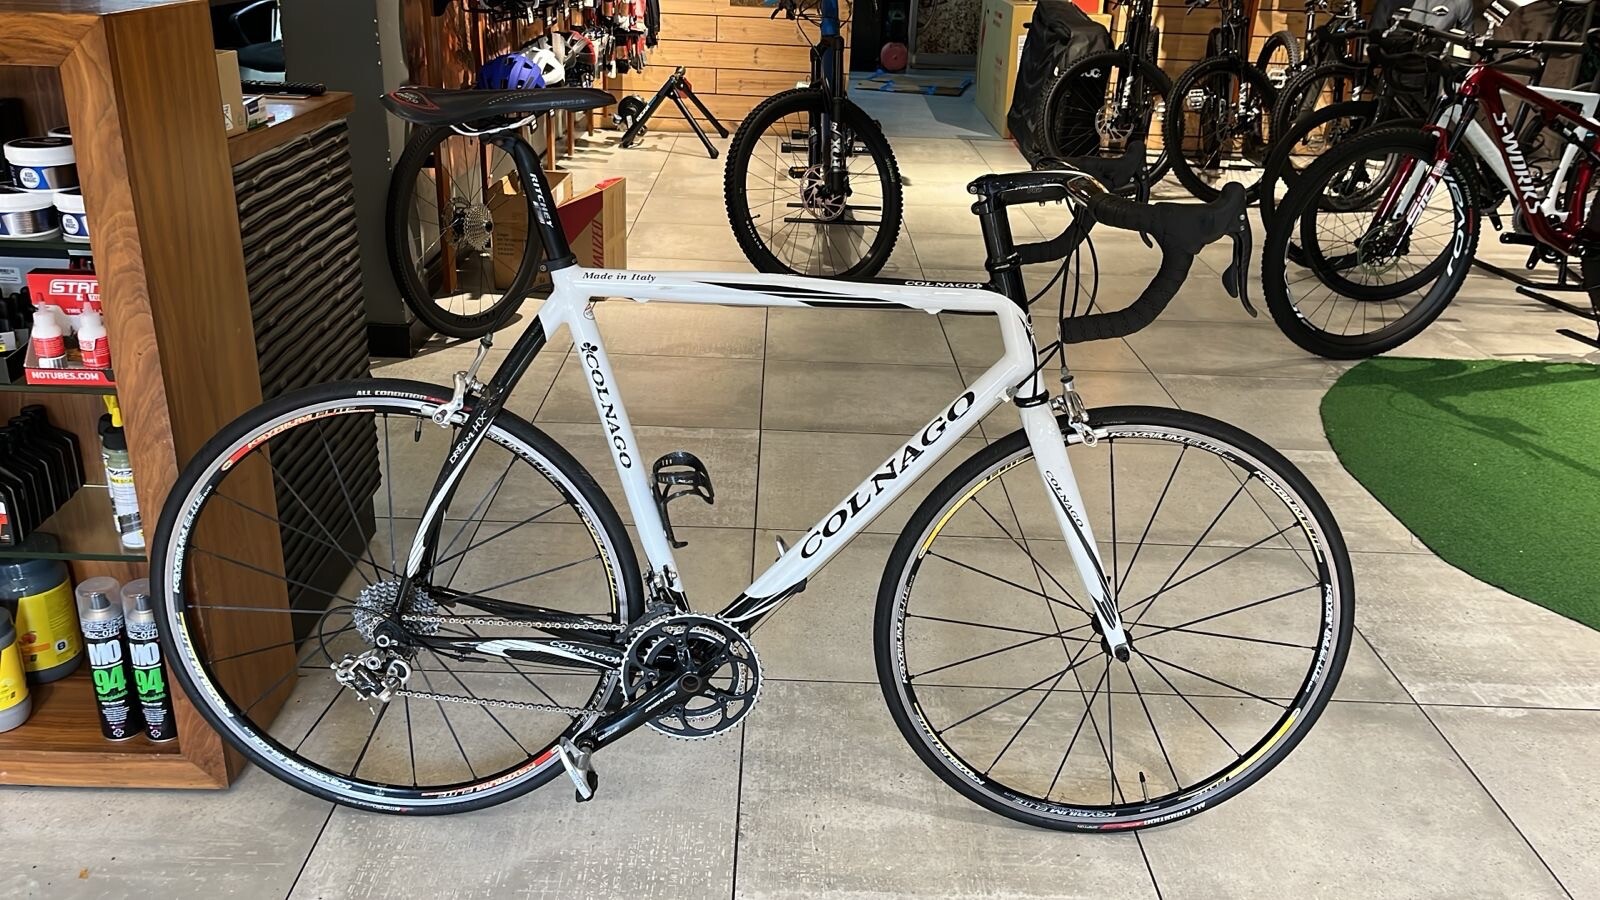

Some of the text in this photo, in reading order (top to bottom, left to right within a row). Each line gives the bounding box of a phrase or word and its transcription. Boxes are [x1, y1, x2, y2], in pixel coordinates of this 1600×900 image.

[831, 138, 841, 168] FOX
[1492, 112, 1541, 213] S-WORKS
[530, 173, 554, 228] RITCHEY
[1407, 174, 1438, 226] SID
[592, 219, 604, 268] IALIZED
[582, 272, 657, 283] Made in Italy
[904, 280, 976, 289] COLNAGO
[31, 371, 99, 381] NOTUBES.COM
[586, 353, 632, 469] COLNAGO
[801, 391, 976, 560] COLNAGO
[1045, 470, 1084, 528] COLNAGO
[87, 639, 122, 666] MO
[129, 641, 160, 667] MO
[549, 640, 615, 662] COLNAGO
[93, 665, 127, 695] 94
[134, 667, 165, 695] 94
[1049, 808, 1117, 818] KSYRIUM
